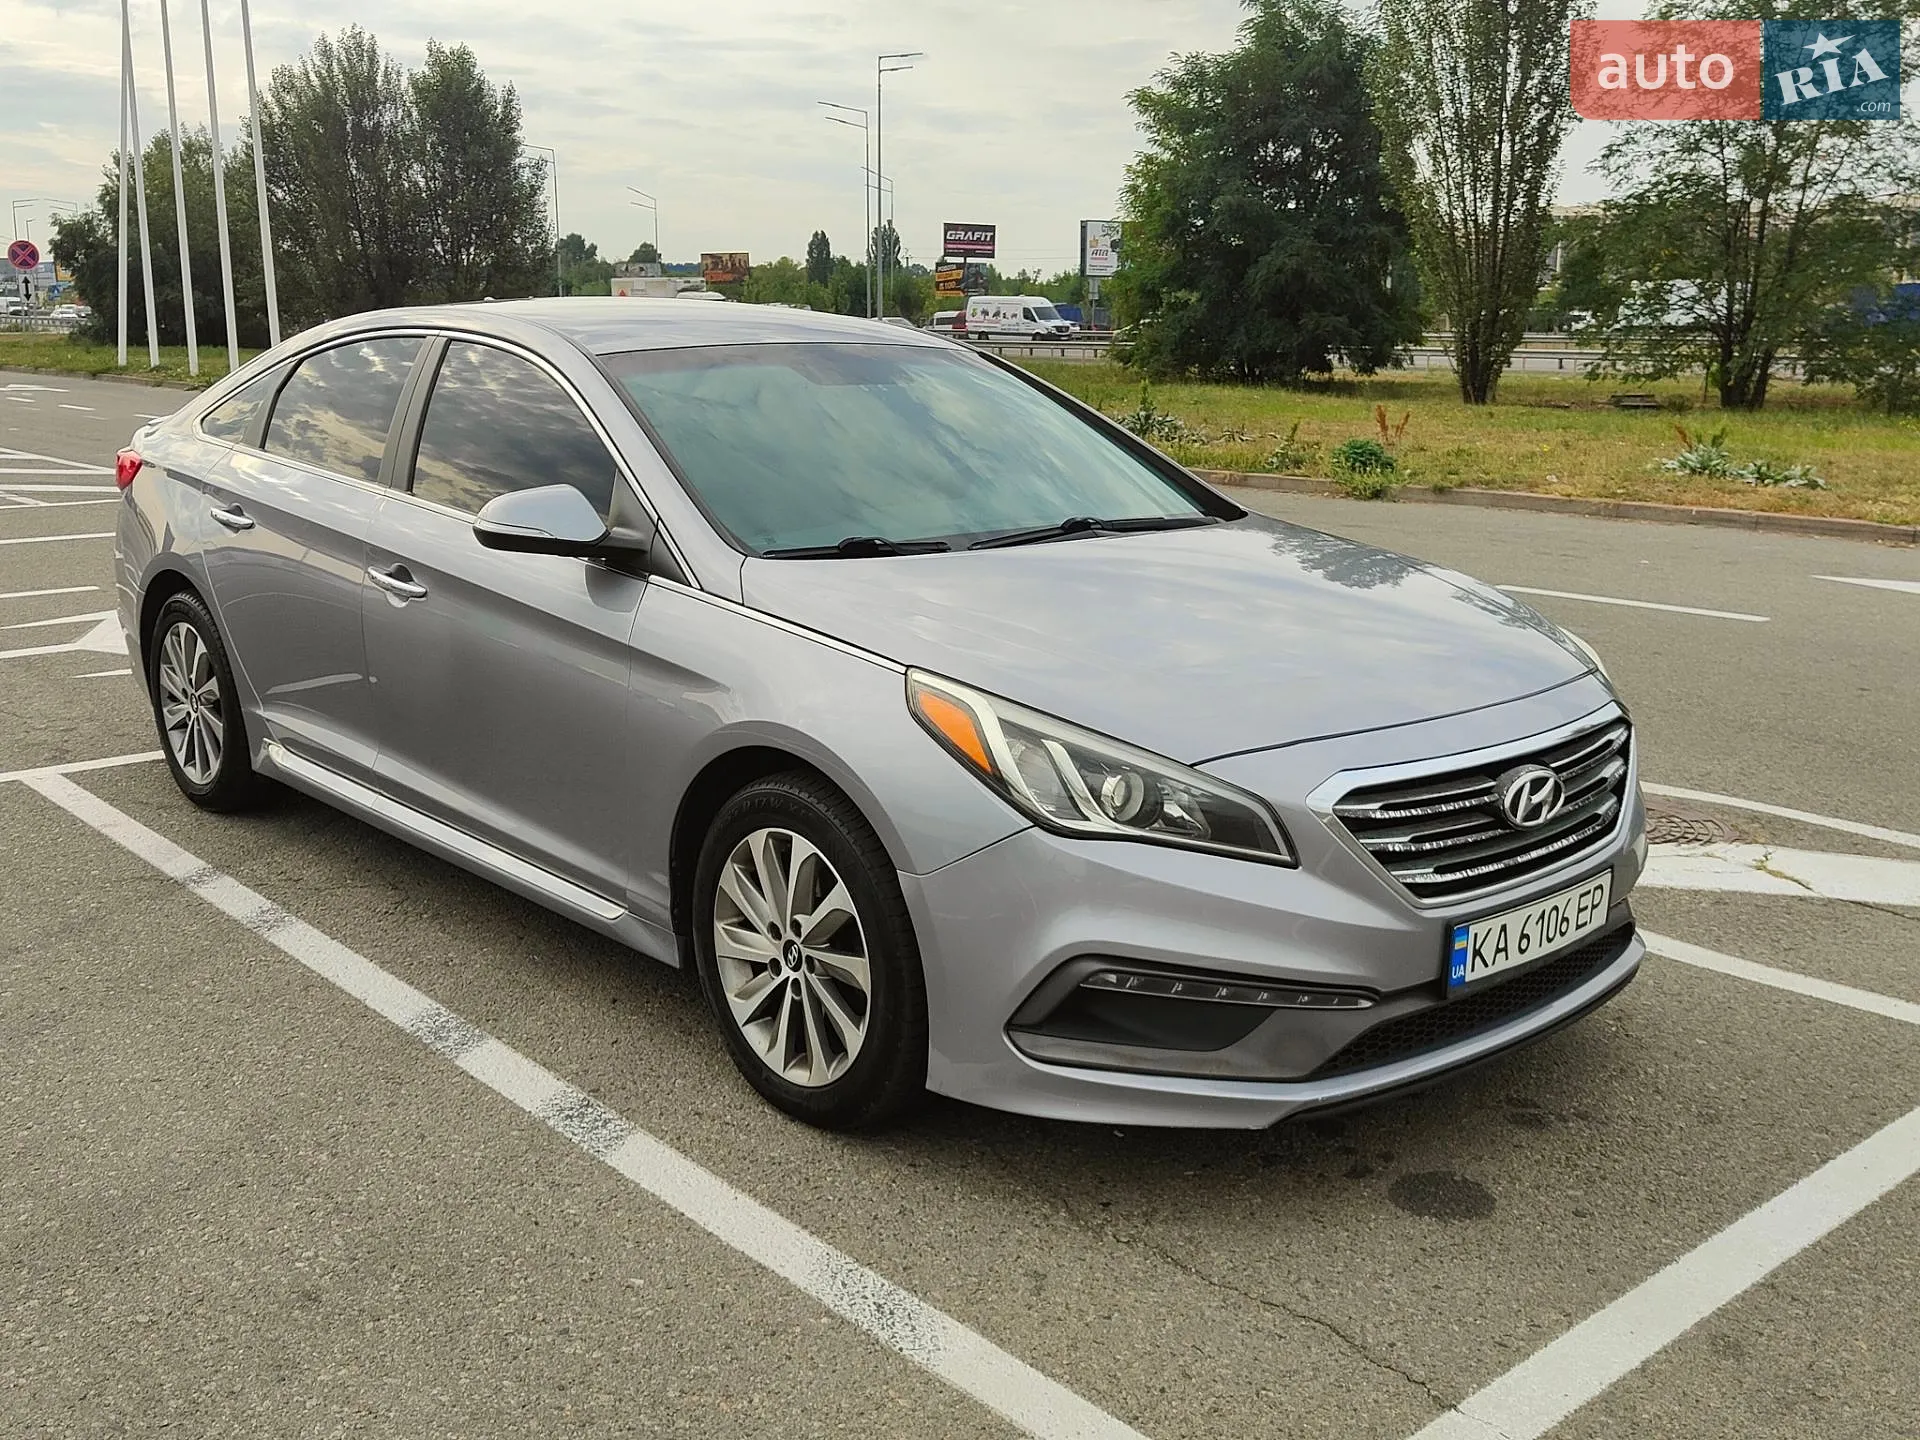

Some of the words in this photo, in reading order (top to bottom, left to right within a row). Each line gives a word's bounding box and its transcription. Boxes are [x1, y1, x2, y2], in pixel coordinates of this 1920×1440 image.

[946, 231, 994, 241] GRAFIT
[1470, 923, 1509, 973] KA
[1517, 898, 1572, 955] 6106
[1575, 883, 1604, 932] EP
[1452, 965, 1465, 980] UA
